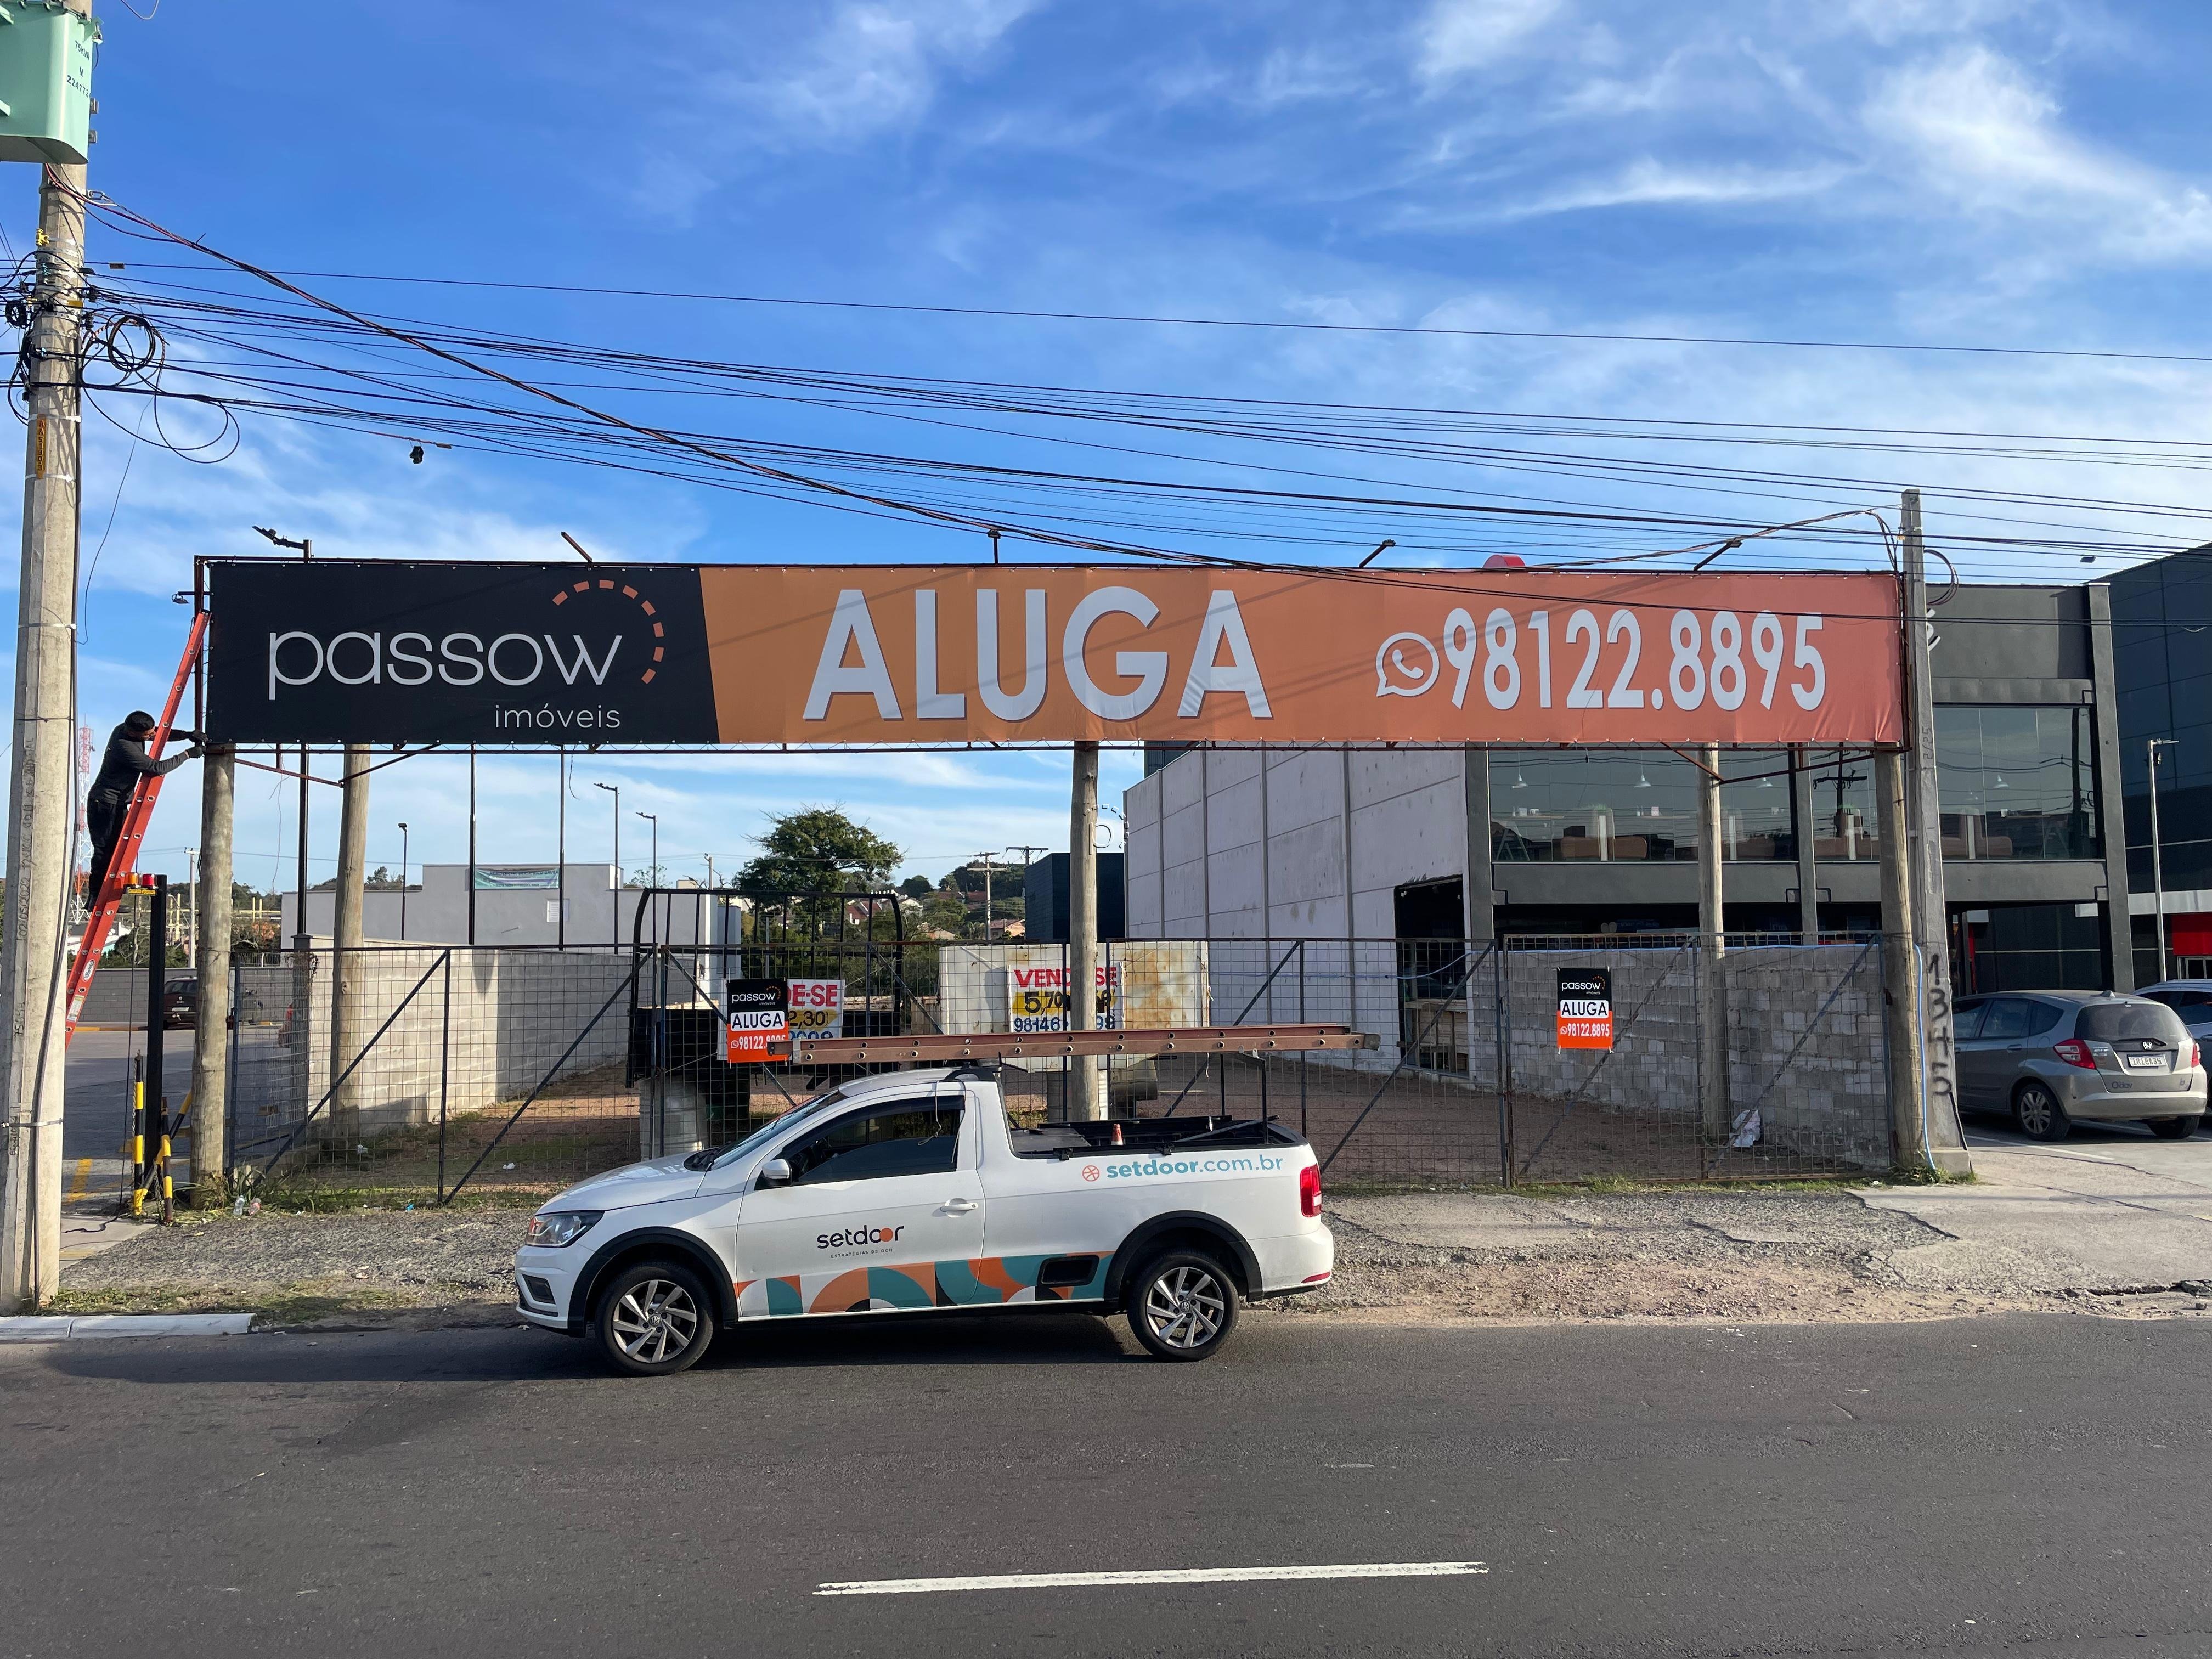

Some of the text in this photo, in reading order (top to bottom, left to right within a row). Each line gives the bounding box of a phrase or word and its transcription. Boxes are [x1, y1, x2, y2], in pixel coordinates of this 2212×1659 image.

[67, 75, 89, 98] 224773
[802, 586, 1274, 721] ALUGA
[1443, 607, 1826, 711] 98122.8895
[268, 630, 623, 701] passow
[495, 703, 620, 729] imóveis
[732, 992, 776, 1004] passow
[1561, 982, 1601, 991] passow
[1561, 1001, 1607, 1015] ALUGA
[732, 1012, 783, 1029] ALUGA
[1567, 1023, 1610, 1037] 98122.8895
[1107, 1154, 1283, 1178] setdoor.com.br
